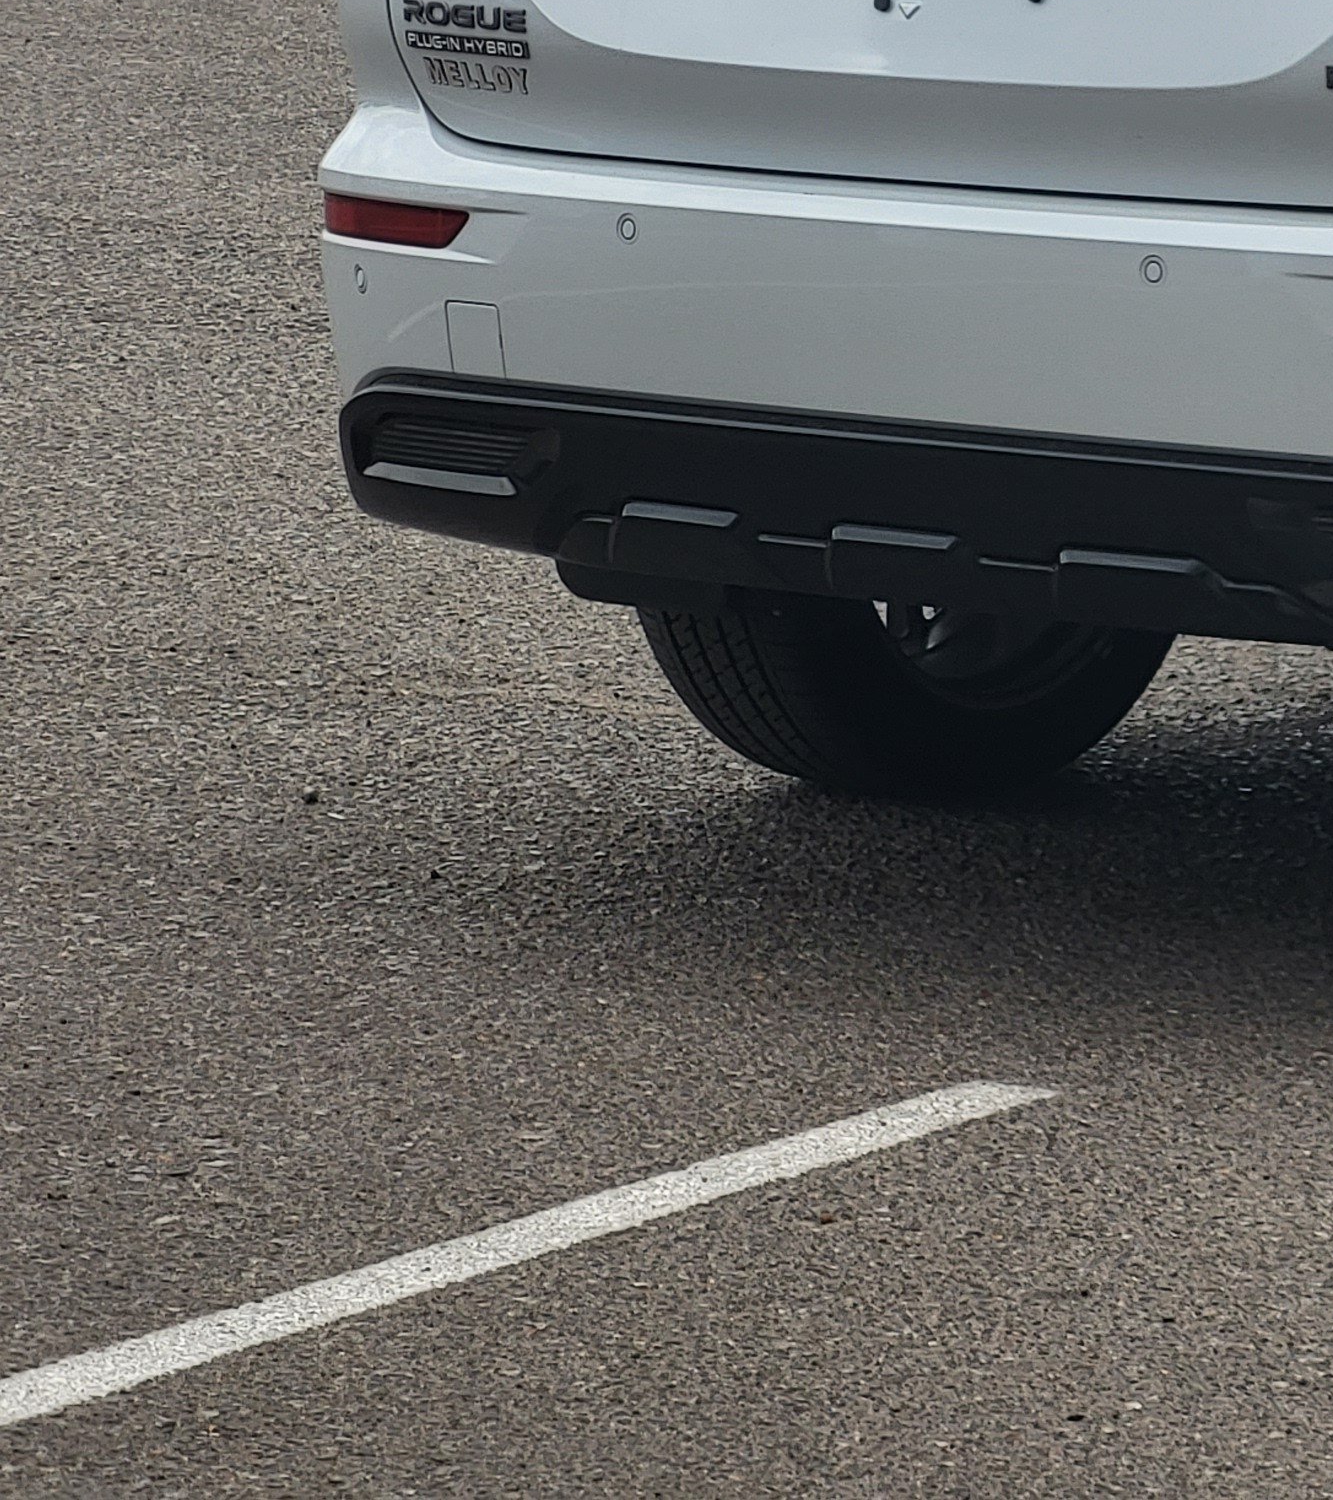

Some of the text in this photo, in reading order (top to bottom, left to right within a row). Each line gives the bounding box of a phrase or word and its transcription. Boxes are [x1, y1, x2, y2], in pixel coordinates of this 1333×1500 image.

[407, 32, 523, 57] PLUG-IN HYBRID
[423, 56, 528, 95] MELLOY
